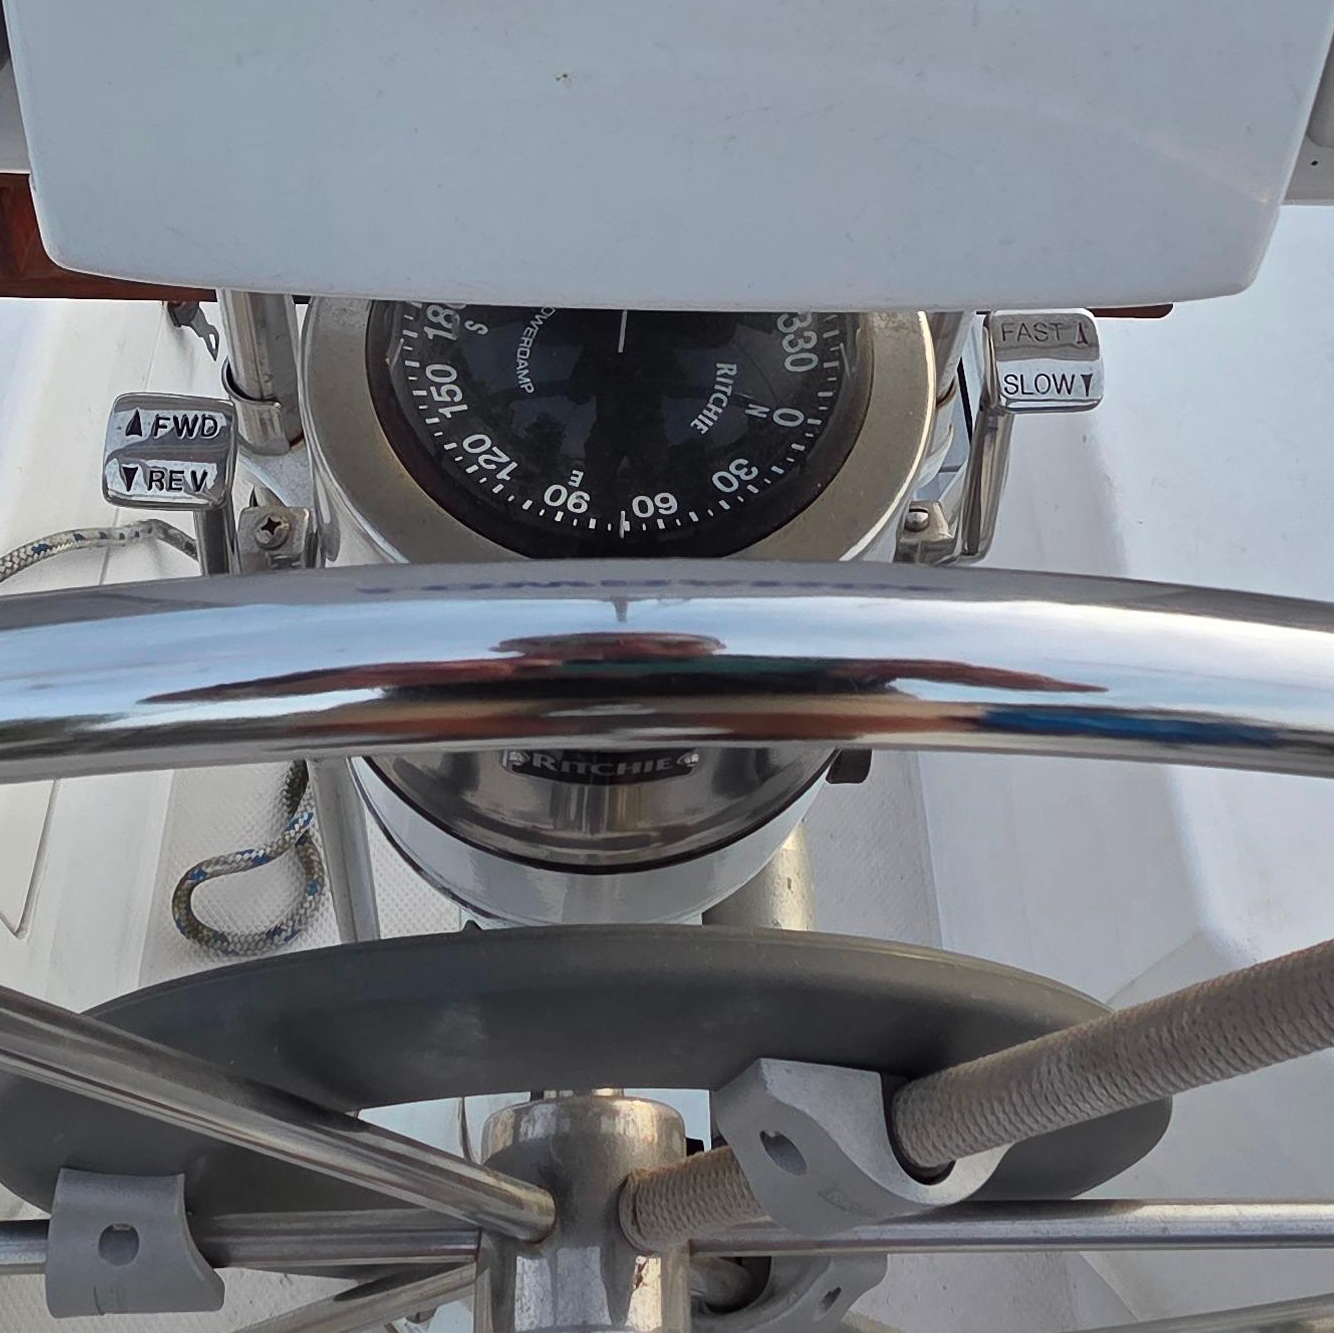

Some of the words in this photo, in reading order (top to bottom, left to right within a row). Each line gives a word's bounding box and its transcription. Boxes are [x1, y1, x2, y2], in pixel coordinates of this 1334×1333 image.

[423, 304, 466, 341] 18
[464, 320, 489, 336] S
[1001, 321, 1065, 343] FAST
[516, 307, 557, 394] OWERDAMP
[776, 311, 819, 373] 330
[424, 363, 468, 419] 150
[1003, 373, 1076, 396] SLOW
[689, 362, 738, 435] RITCHIE
[744, 402, 771, 419] N
[152, 414, 219, 439] FWD
[772, 407, 805, 428] 0
[462, 433, 519, 482] 120
[147, 469, 209, 493] REV
[568, 469, 585, 488] E
[711, 457, 760, 494] 30
[543, 484, 592, 514] 90
[631, 492, 679, 519] 60
[532, 752, 675, 777] RITCHIE
